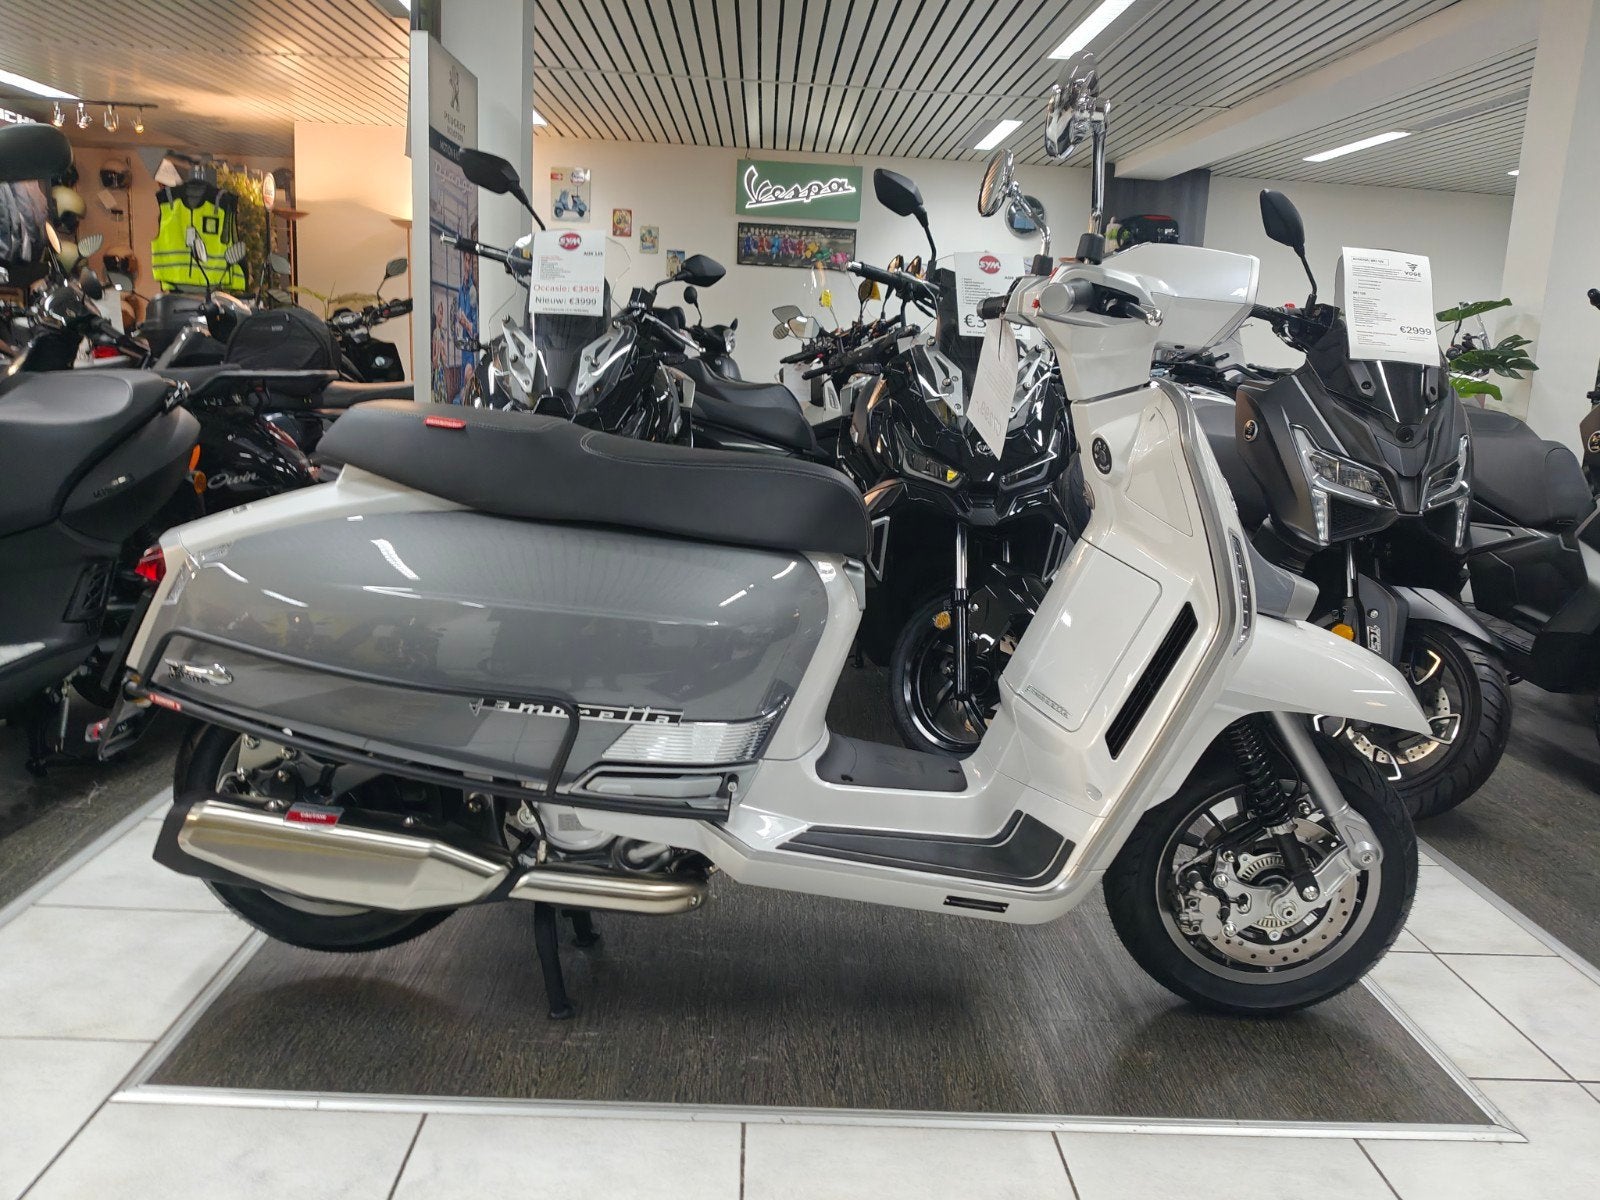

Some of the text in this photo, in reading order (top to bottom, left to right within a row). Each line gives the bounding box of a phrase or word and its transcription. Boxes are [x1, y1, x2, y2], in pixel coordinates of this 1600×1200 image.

[744, 165, 856, 208] Vespa
[559, 237, 582, 248] SYM
[979, 260, 1001, 270] SYM
[533, 283, 600, 294] Occasie: €3495
[535, 297, 597, 307] Nieuw: €3999
[1400, 325, 1432, 336] €2999
